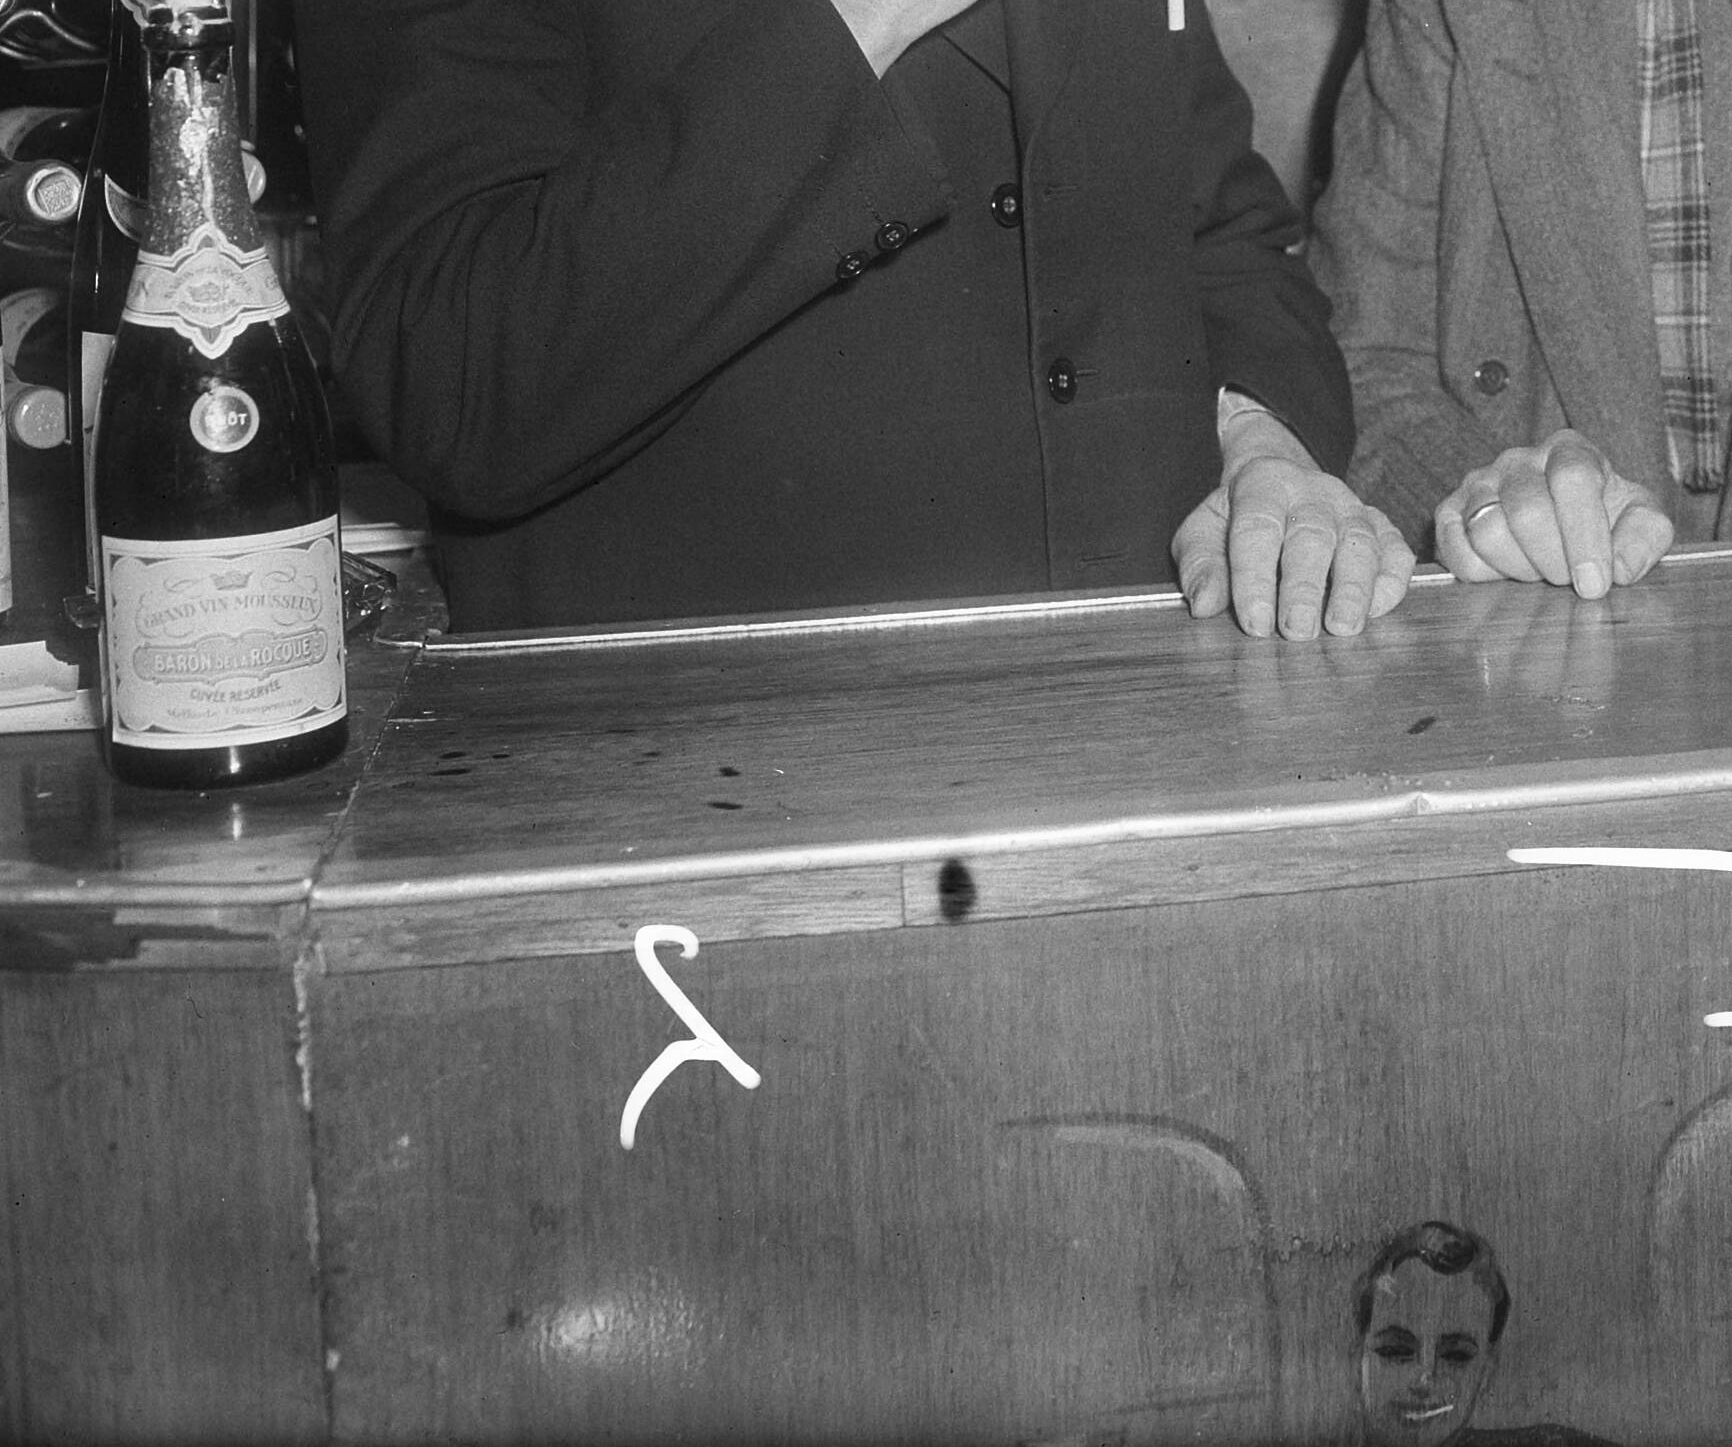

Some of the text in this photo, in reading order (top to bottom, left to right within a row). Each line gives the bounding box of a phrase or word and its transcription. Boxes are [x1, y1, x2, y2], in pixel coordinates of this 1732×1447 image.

[199, 596, 230, 614] VIN
[154, 653, 212, 672] BARON
[251, 638, 312, 666] ROCQUE
